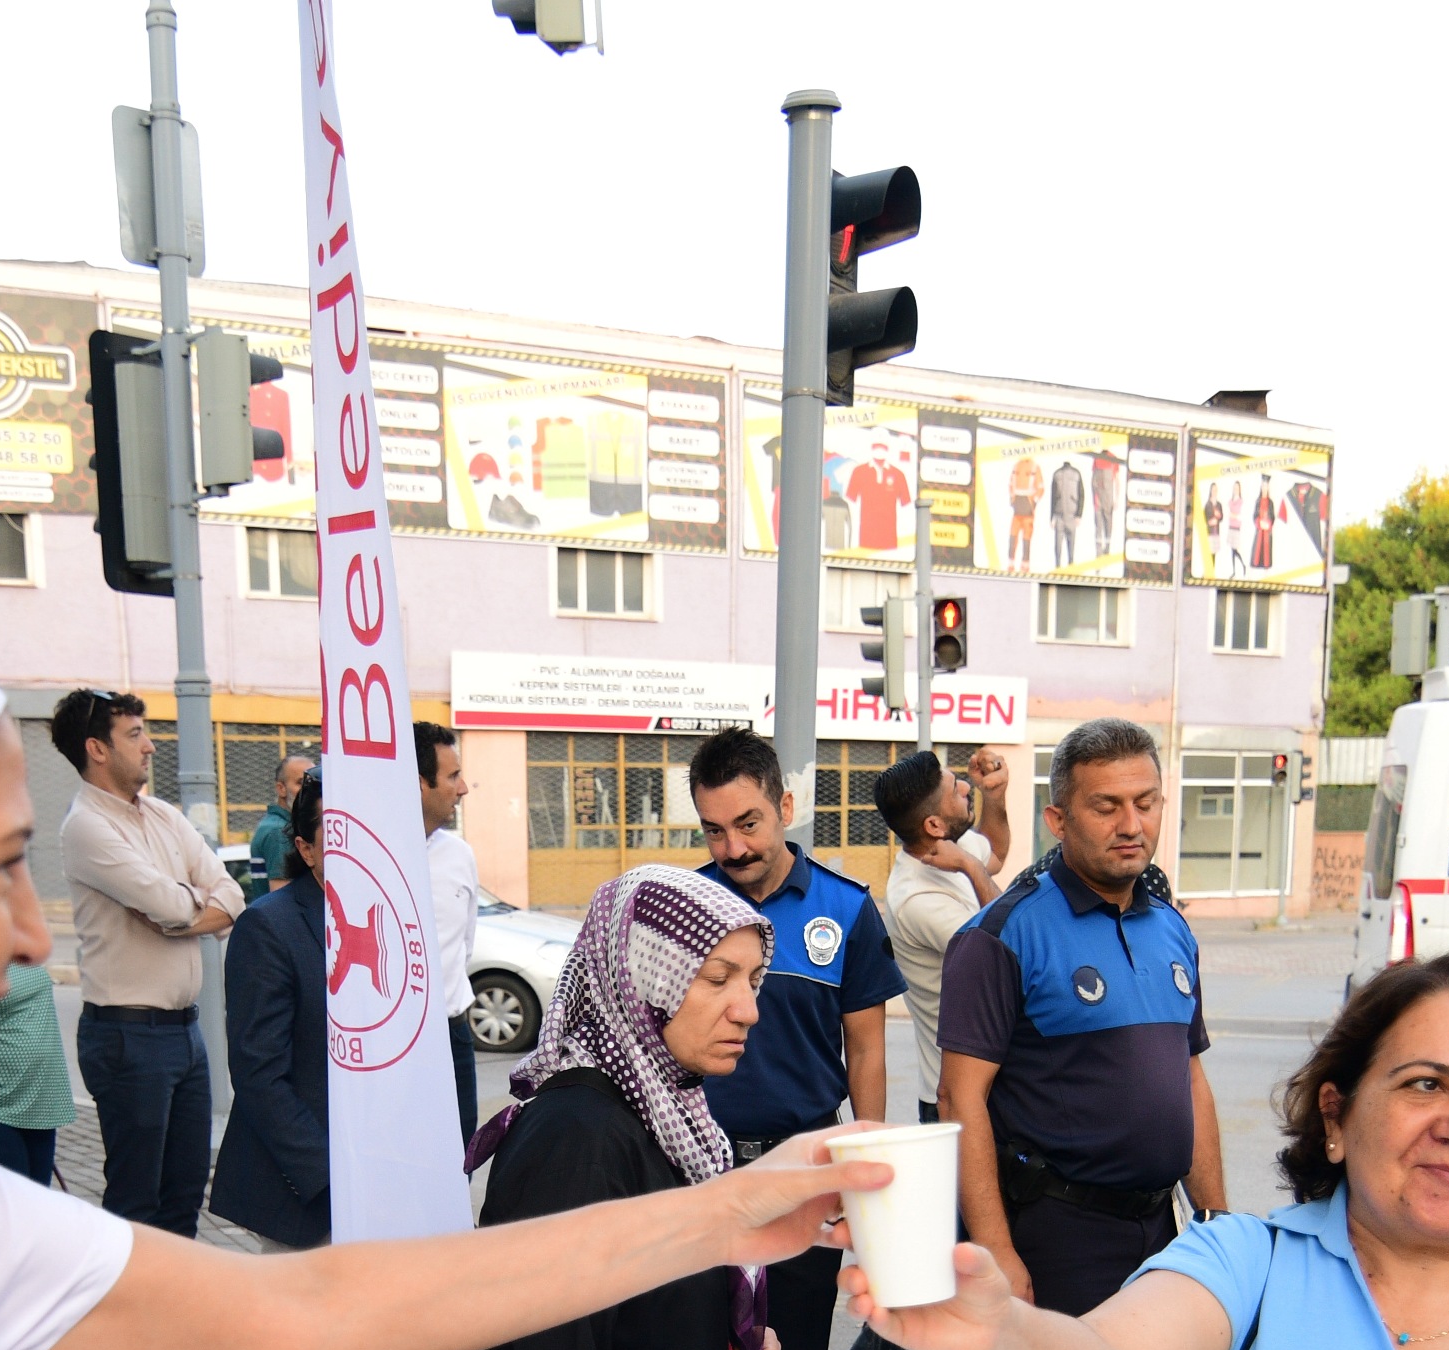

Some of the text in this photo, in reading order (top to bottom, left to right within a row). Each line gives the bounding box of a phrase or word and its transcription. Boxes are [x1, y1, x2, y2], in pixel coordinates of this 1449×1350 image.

[19, 431, 36, 444] 32
[43, 433, 62, 445] 50
[20, 451, 39, 464] 58
[46, 453, 63, 466] 10
[539, 666, 560, 676] PVC
[468, 694, 525, 705] KORKULUK
[405, 921, 425, 996] 1881
